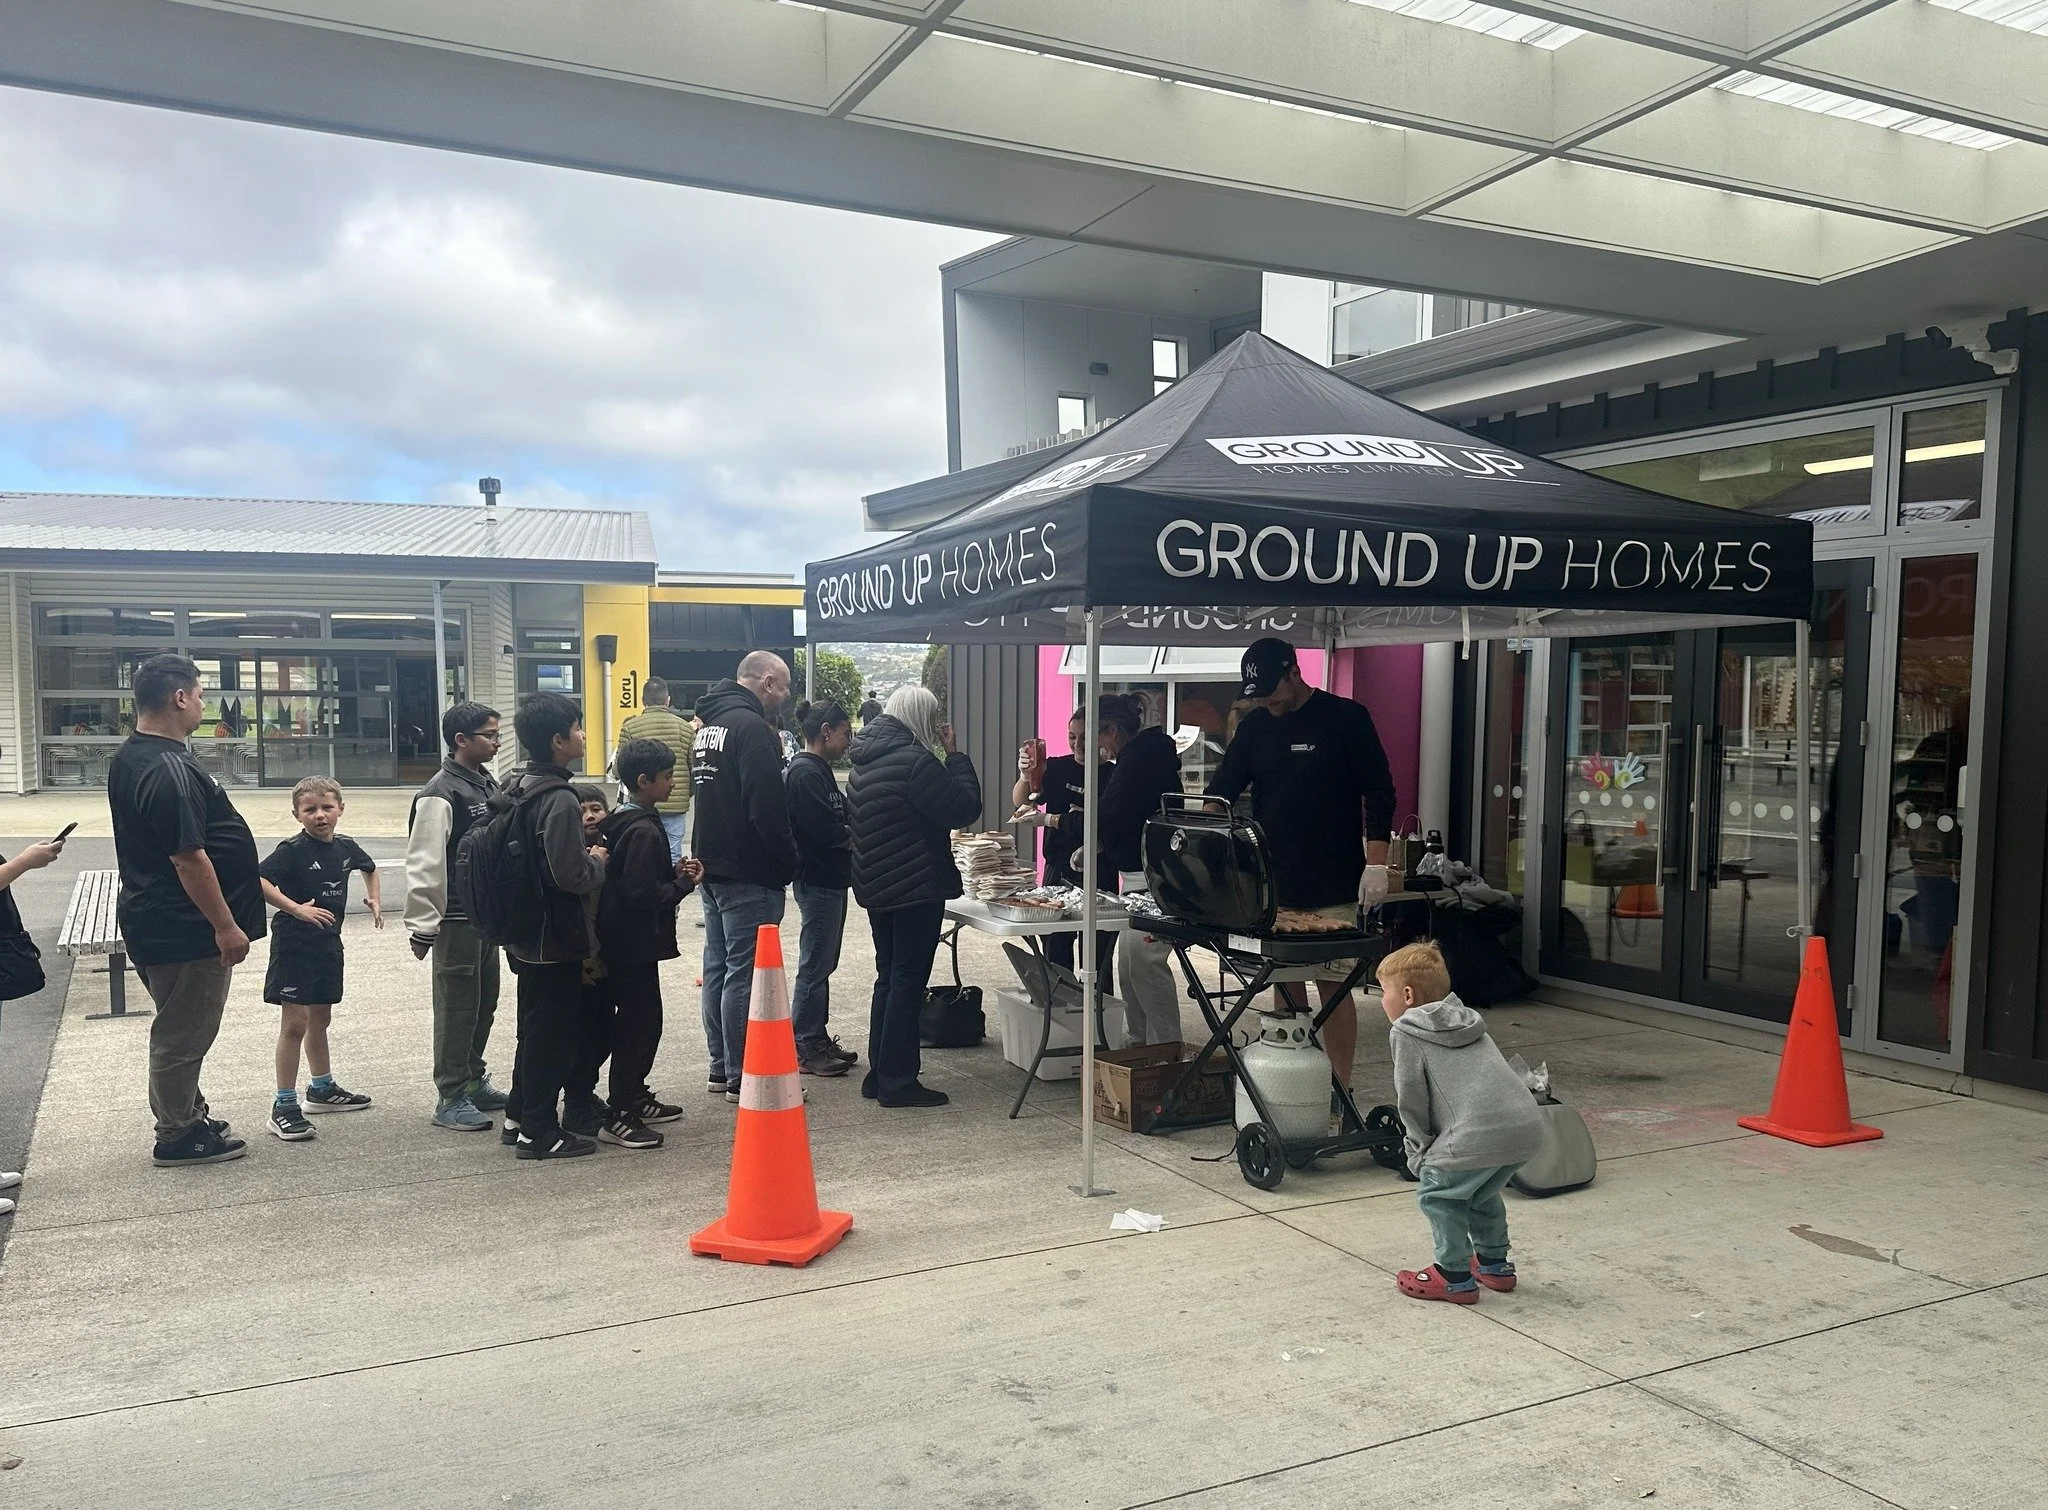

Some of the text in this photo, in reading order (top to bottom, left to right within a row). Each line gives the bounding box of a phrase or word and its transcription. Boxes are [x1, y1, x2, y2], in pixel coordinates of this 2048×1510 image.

[1227, 440, 1525, 478] GROUND UP
[1250, 463, 1455, 478] HOMES LIMITED
[816, 522, 1057, 620] GROUND UP HOMES
[1156, 519, 1771, 592] GROUND UP HOMES
[620, 678, 631, 708] Koru
